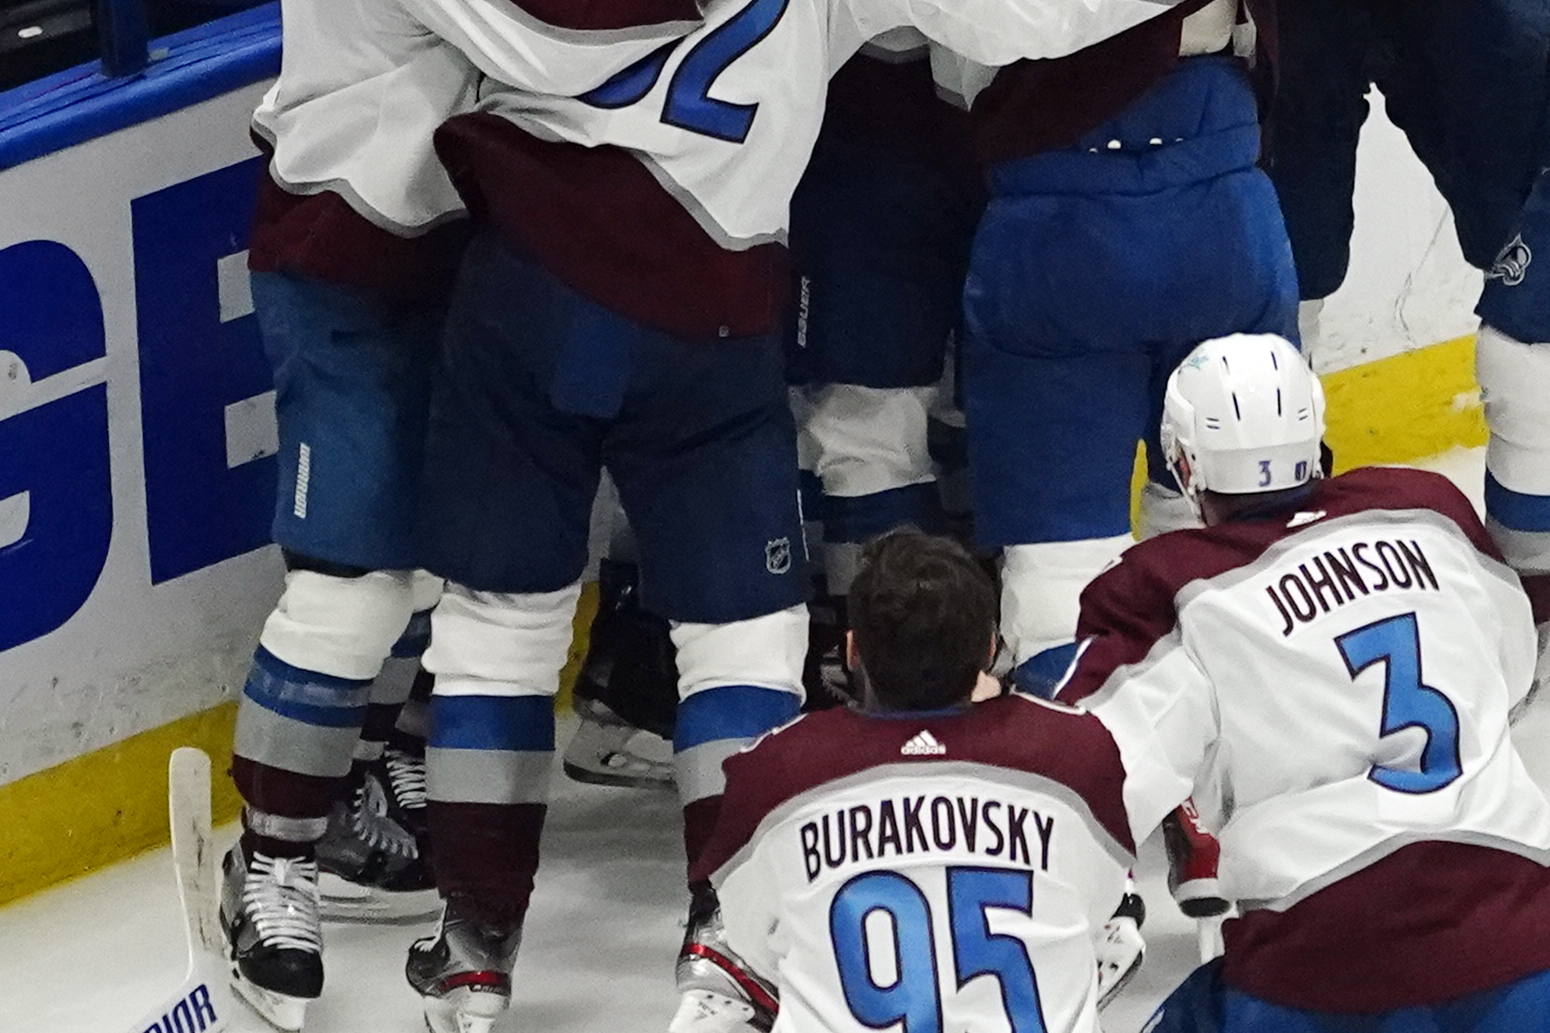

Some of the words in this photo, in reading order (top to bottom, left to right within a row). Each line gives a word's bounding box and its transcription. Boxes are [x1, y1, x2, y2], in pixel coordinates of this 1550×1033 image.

[1265, 539, 1440, 638] JOHNSON
[1333, 611, 1464, 795] 3
[800, 795, 1055, 884] BURAKOVSKY
[829, 866, 1051, 1033] 95
